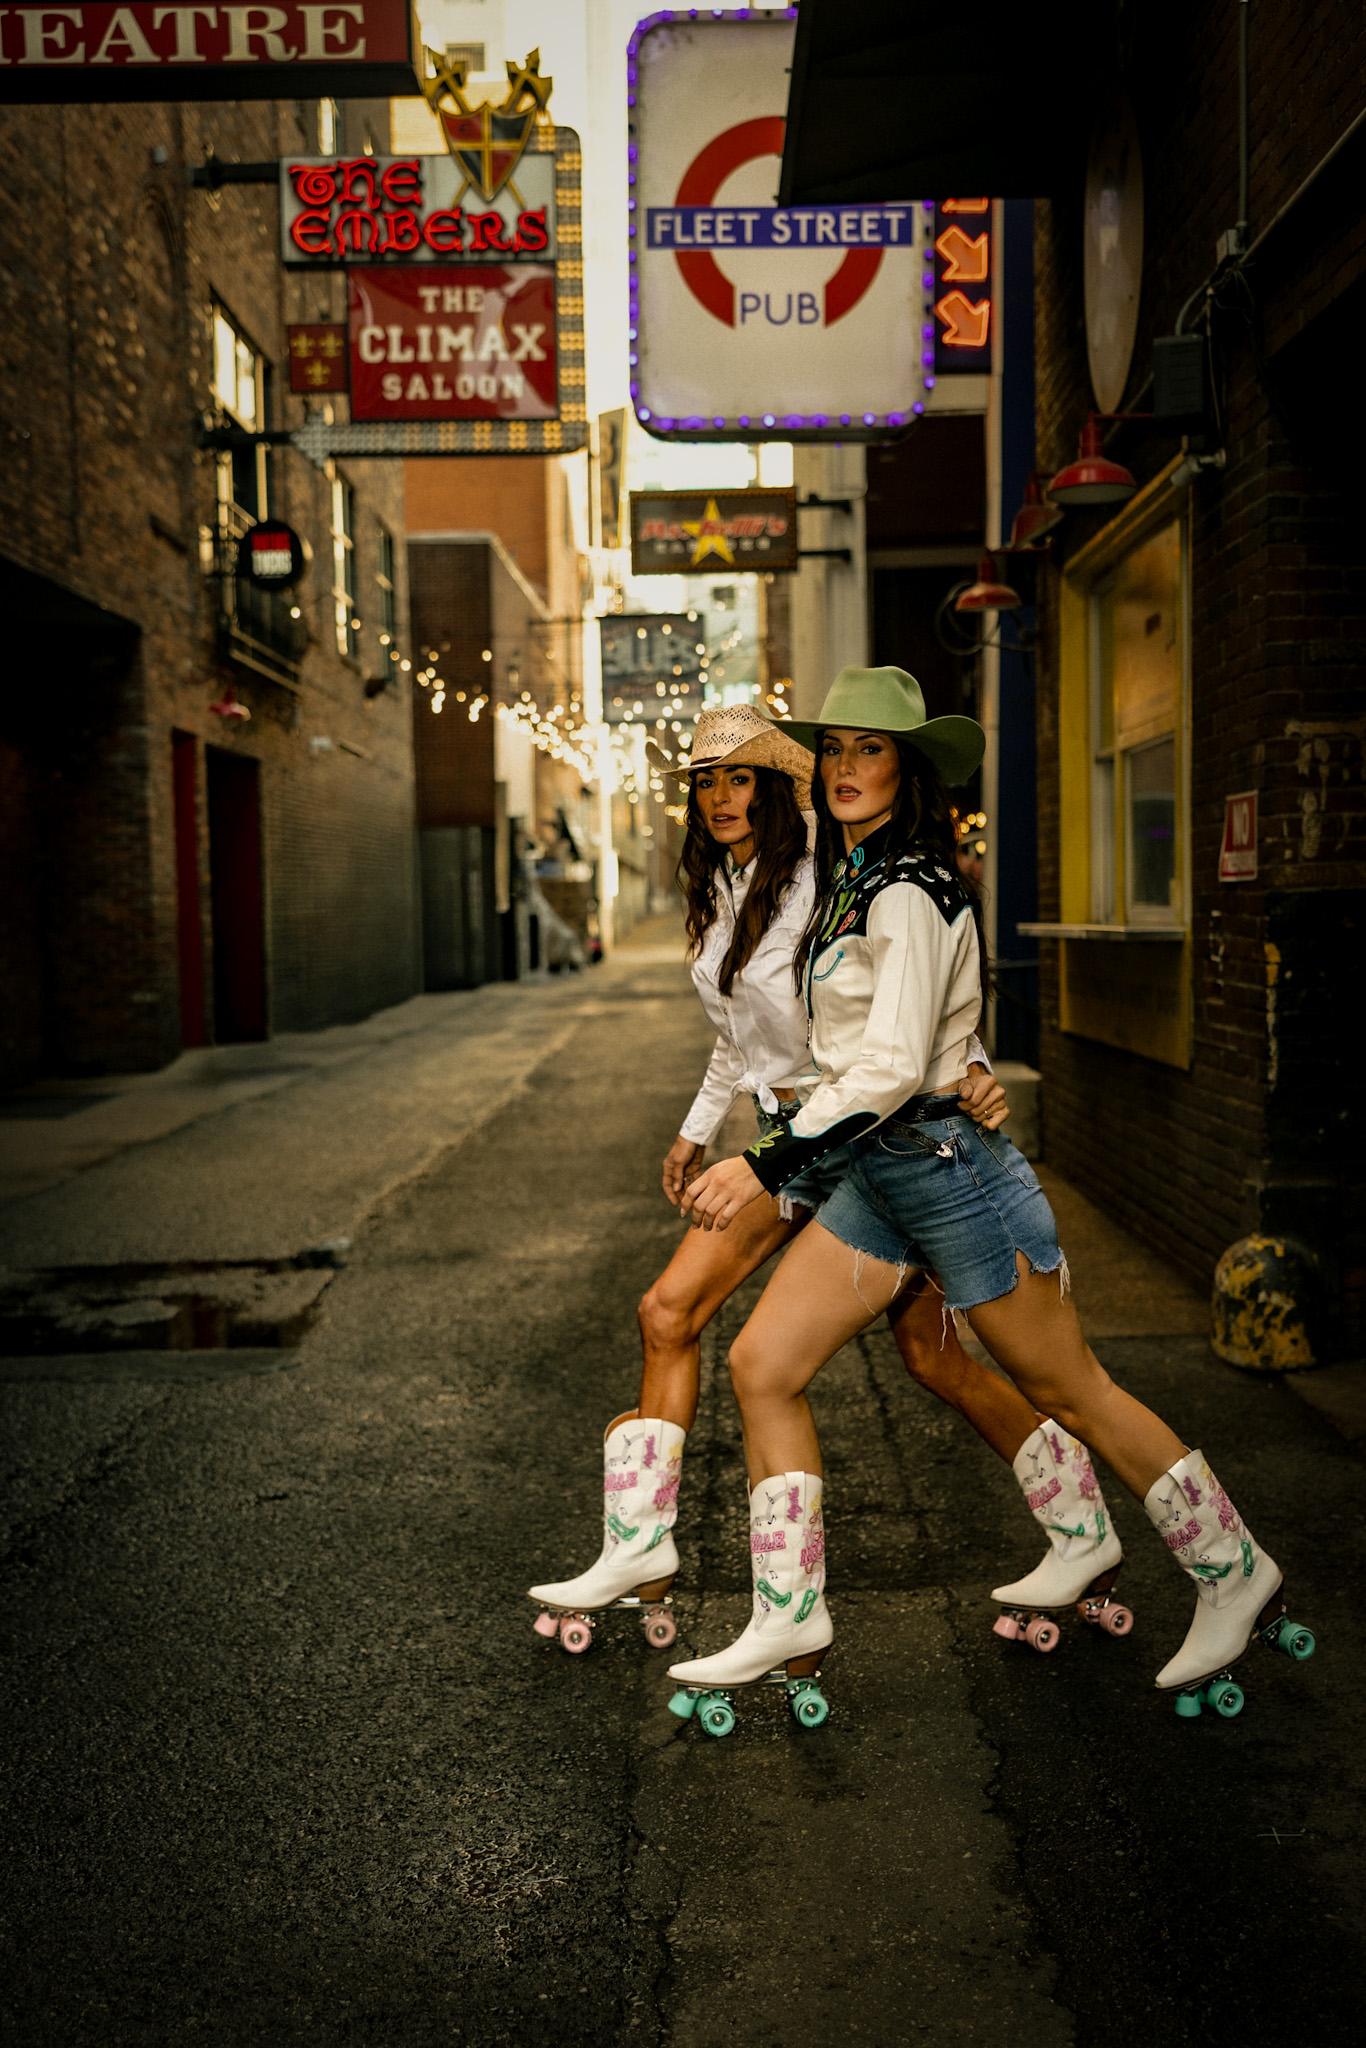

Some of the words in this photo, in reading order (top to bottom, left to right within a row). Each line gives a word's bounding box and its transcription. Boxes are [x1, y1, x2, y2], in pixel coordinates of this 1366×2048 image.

[290, 206, 549, 256] EMBERS
[654, 214, 760, 245] FLEET
[771, 211, 906, 244] STREET
[418, 286, 486, 313] THE
[741, 293, 820, 325] PUB
[358, 324, 547, 363] CLIMAX
[382, 373, 525, 401] SALOON
